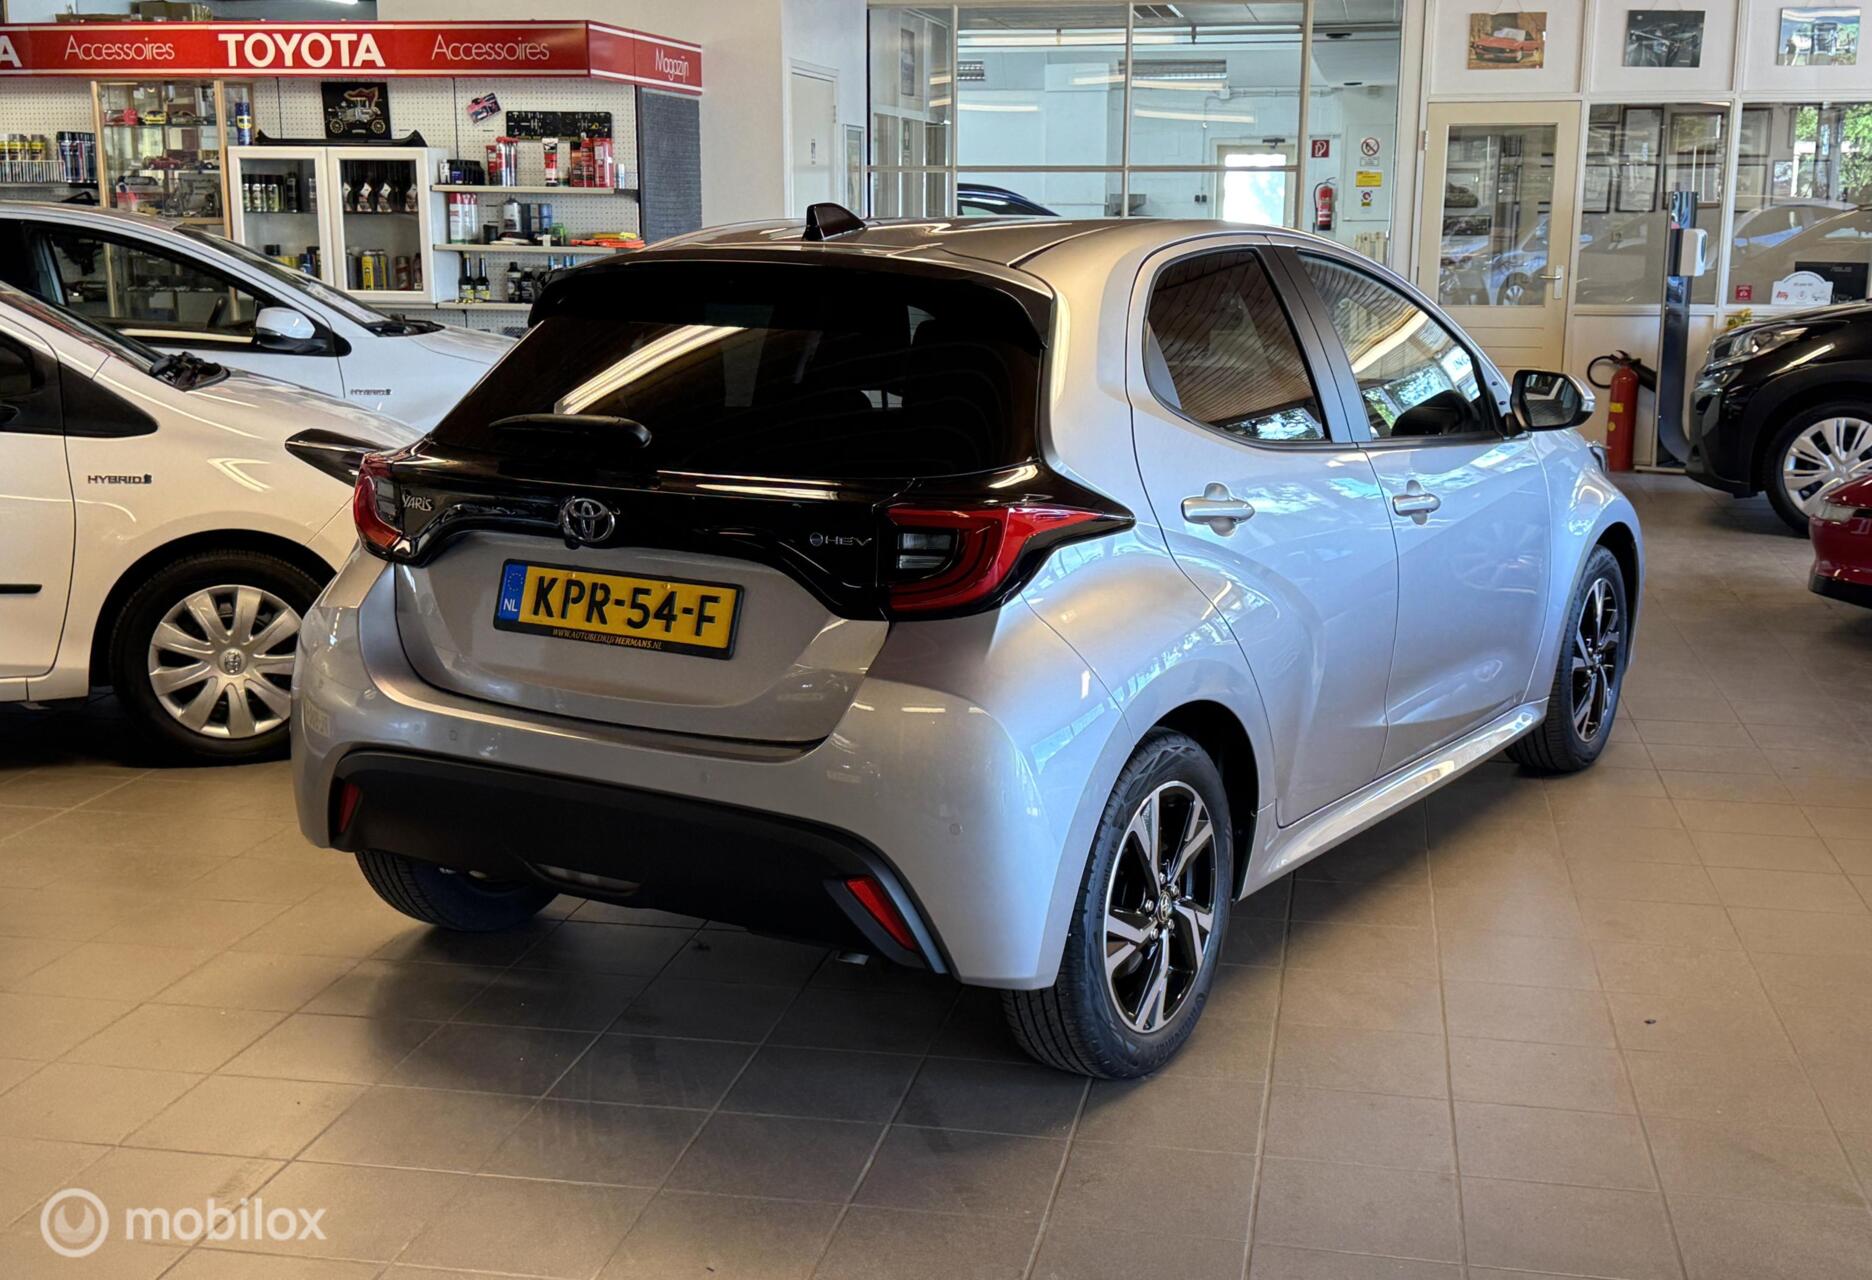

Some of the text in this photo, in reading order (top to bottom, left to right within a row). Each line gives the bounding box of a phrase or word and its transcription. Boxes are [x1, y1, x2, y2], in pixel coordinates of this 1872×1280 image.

[64, 35, 175, 60] Accessoires
[218, 32, 386, 68] TOYOTA
[431, 33, 550, 61] Accessoires
[655, 48, 689, 82] Magazijn
[87, 475, 142, 484] HYBRID
[825, 536, 872, 546] HEV
[503, 598, 519, 612] NL
[532, 576, 720, 637] KPR-54-F
